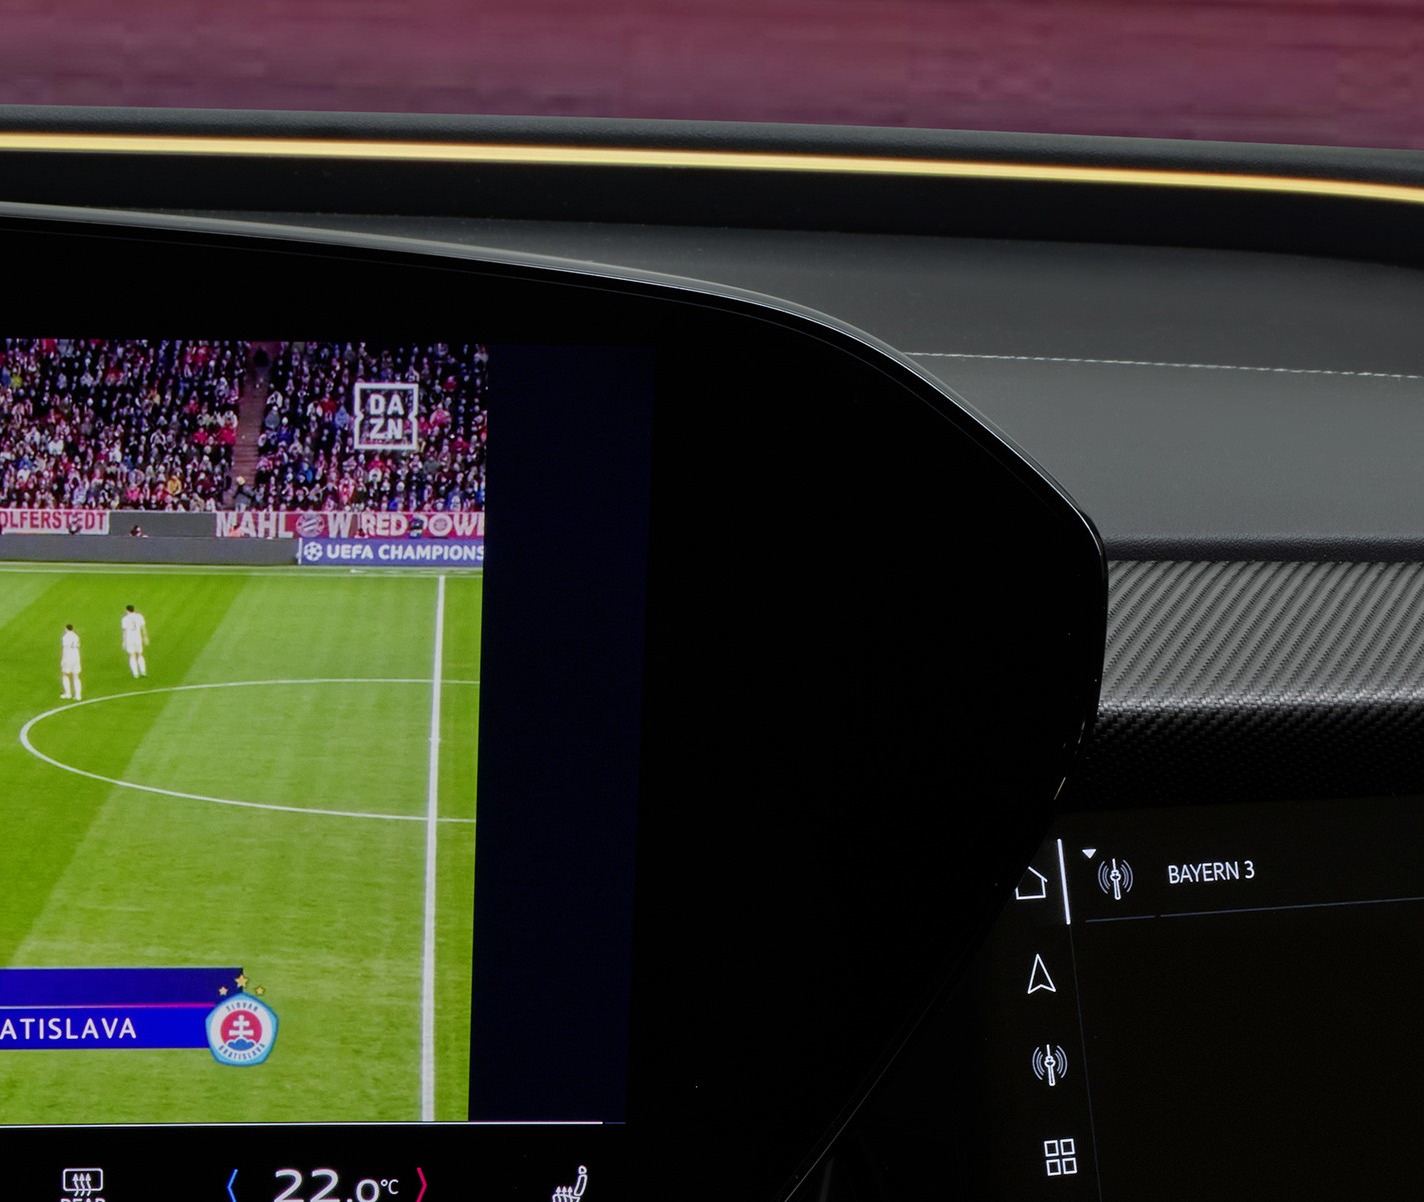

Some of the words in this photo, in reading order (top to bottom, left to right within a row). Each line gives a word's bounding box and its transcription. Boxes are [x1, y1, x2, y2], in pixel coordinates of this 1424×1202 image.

[362, 511, 409, 536] RED
[326, 544, 374, 560] UEFA
[377, 545, 485, 561] CHAMPIONS
[1168, 861, 1239, 884] BAYERN
[1243, 860, 1256, 880] 3
